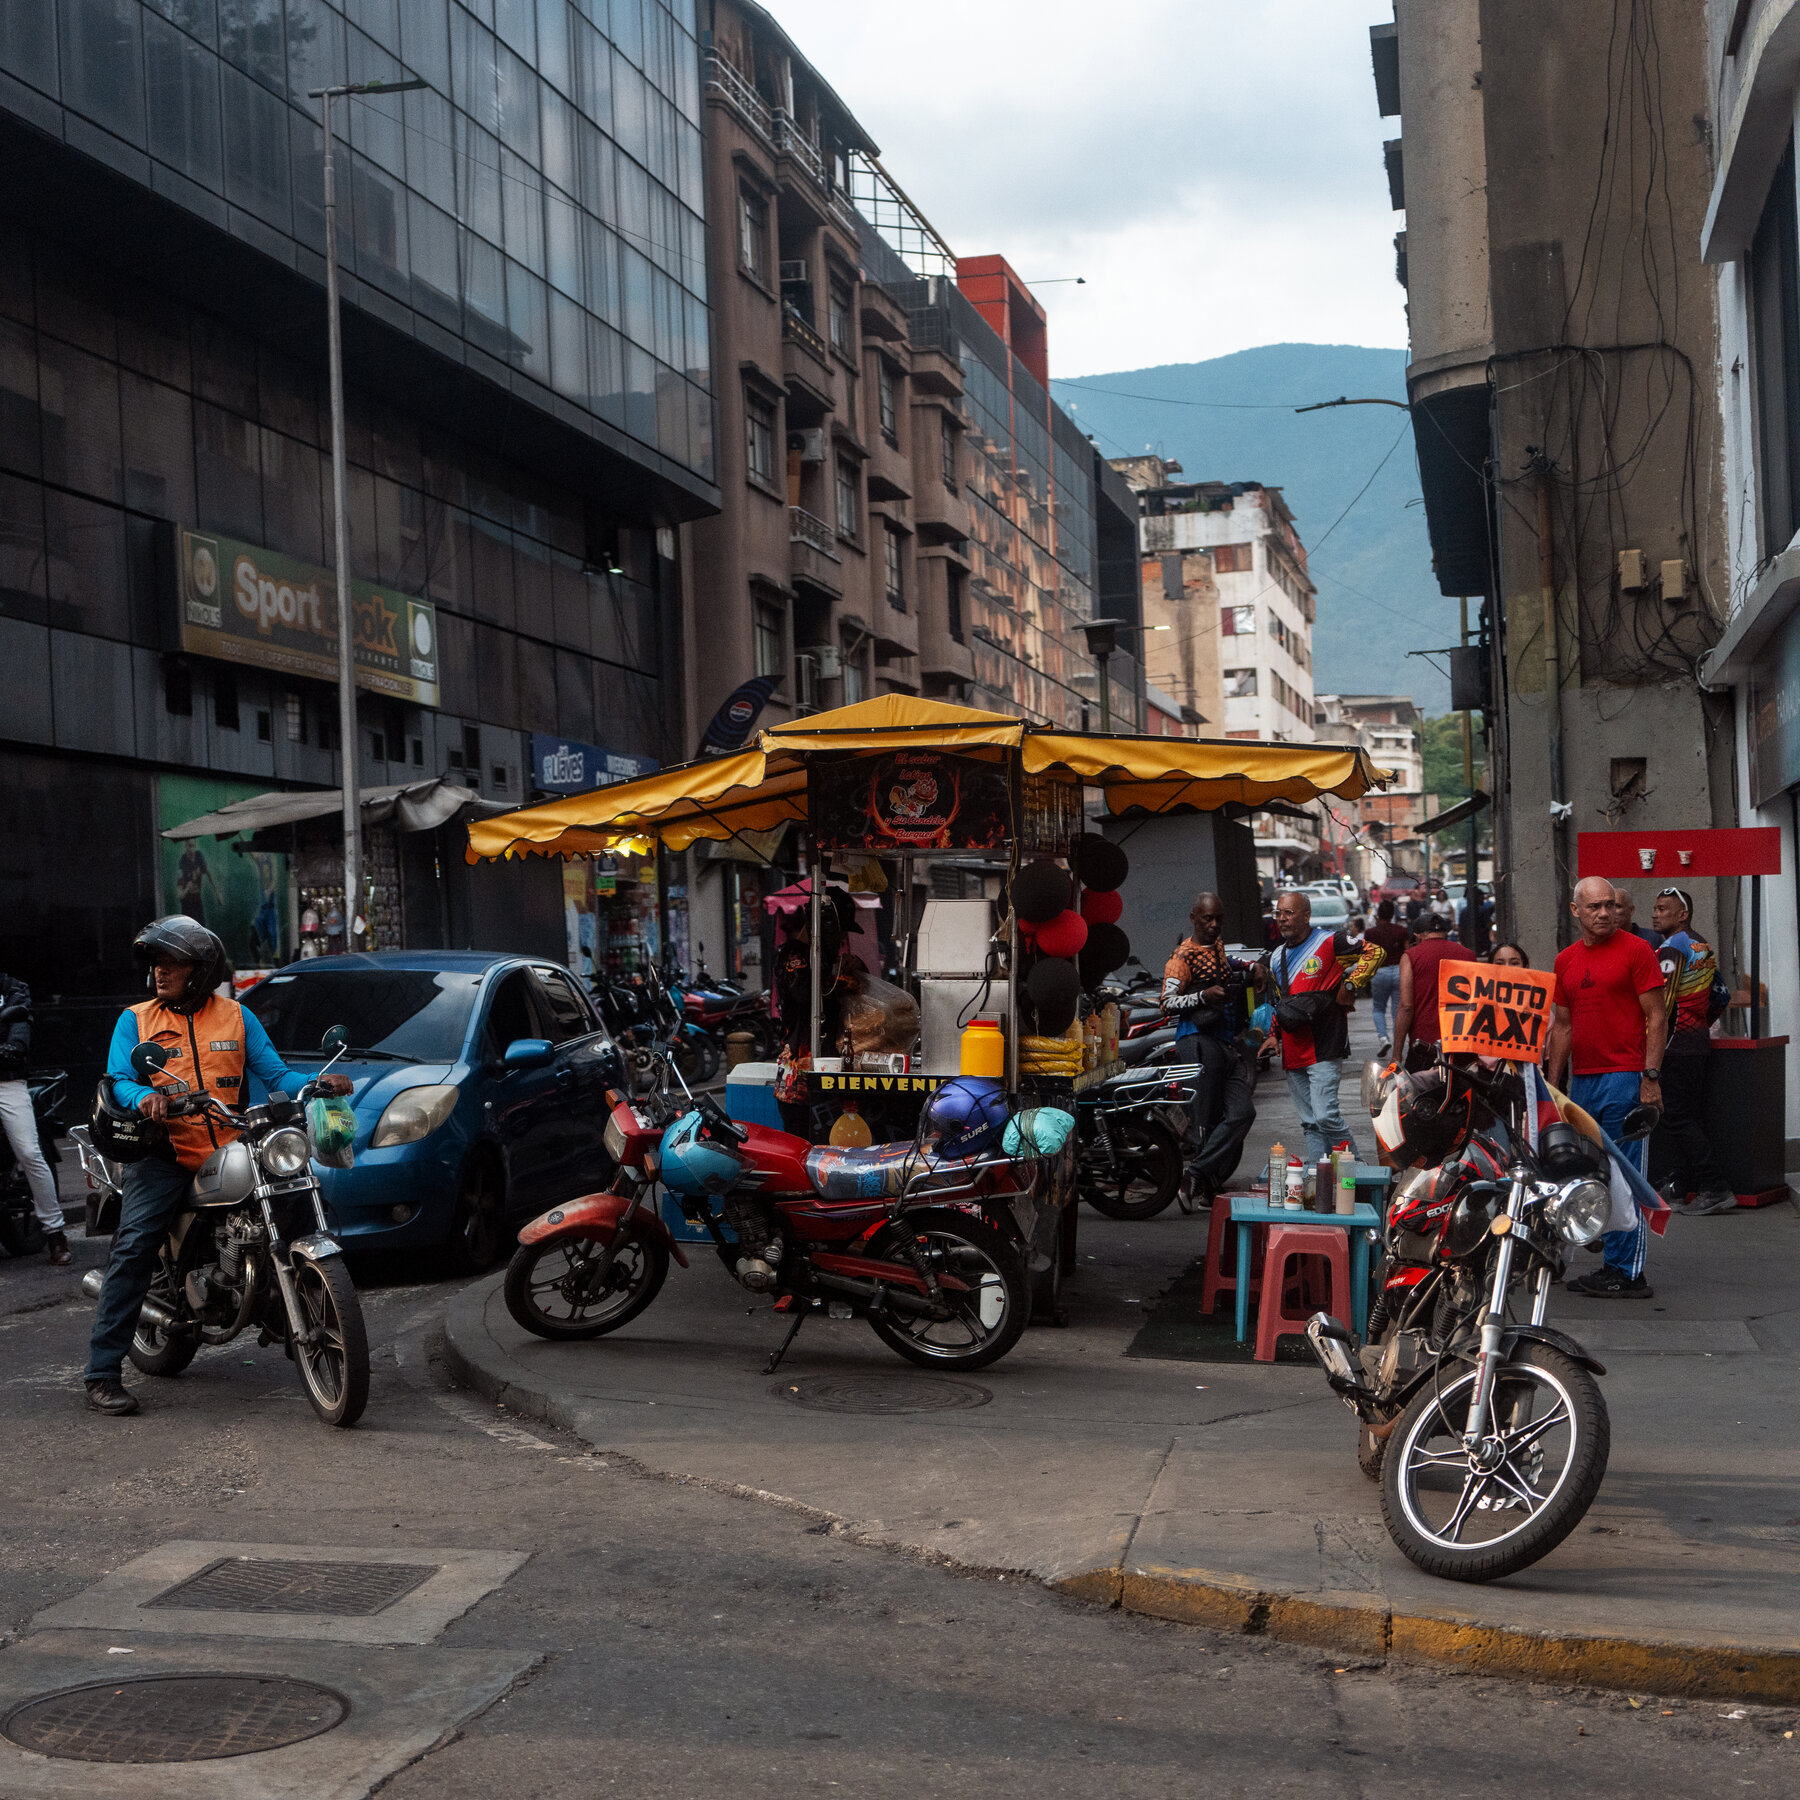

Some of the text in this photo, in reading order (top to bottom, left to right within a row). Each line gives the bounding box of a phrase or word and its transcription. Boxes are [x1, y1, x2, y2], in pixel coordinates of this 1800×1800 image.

[895, 752, 941, 764] El sabor
[895, 829, 935, 840] Burguer
[1474, 976, 1547, 1010] MOTO
[1445, 1002, 1543, 1046] TAXI
[960, 1121, 989, 1144] SURE
